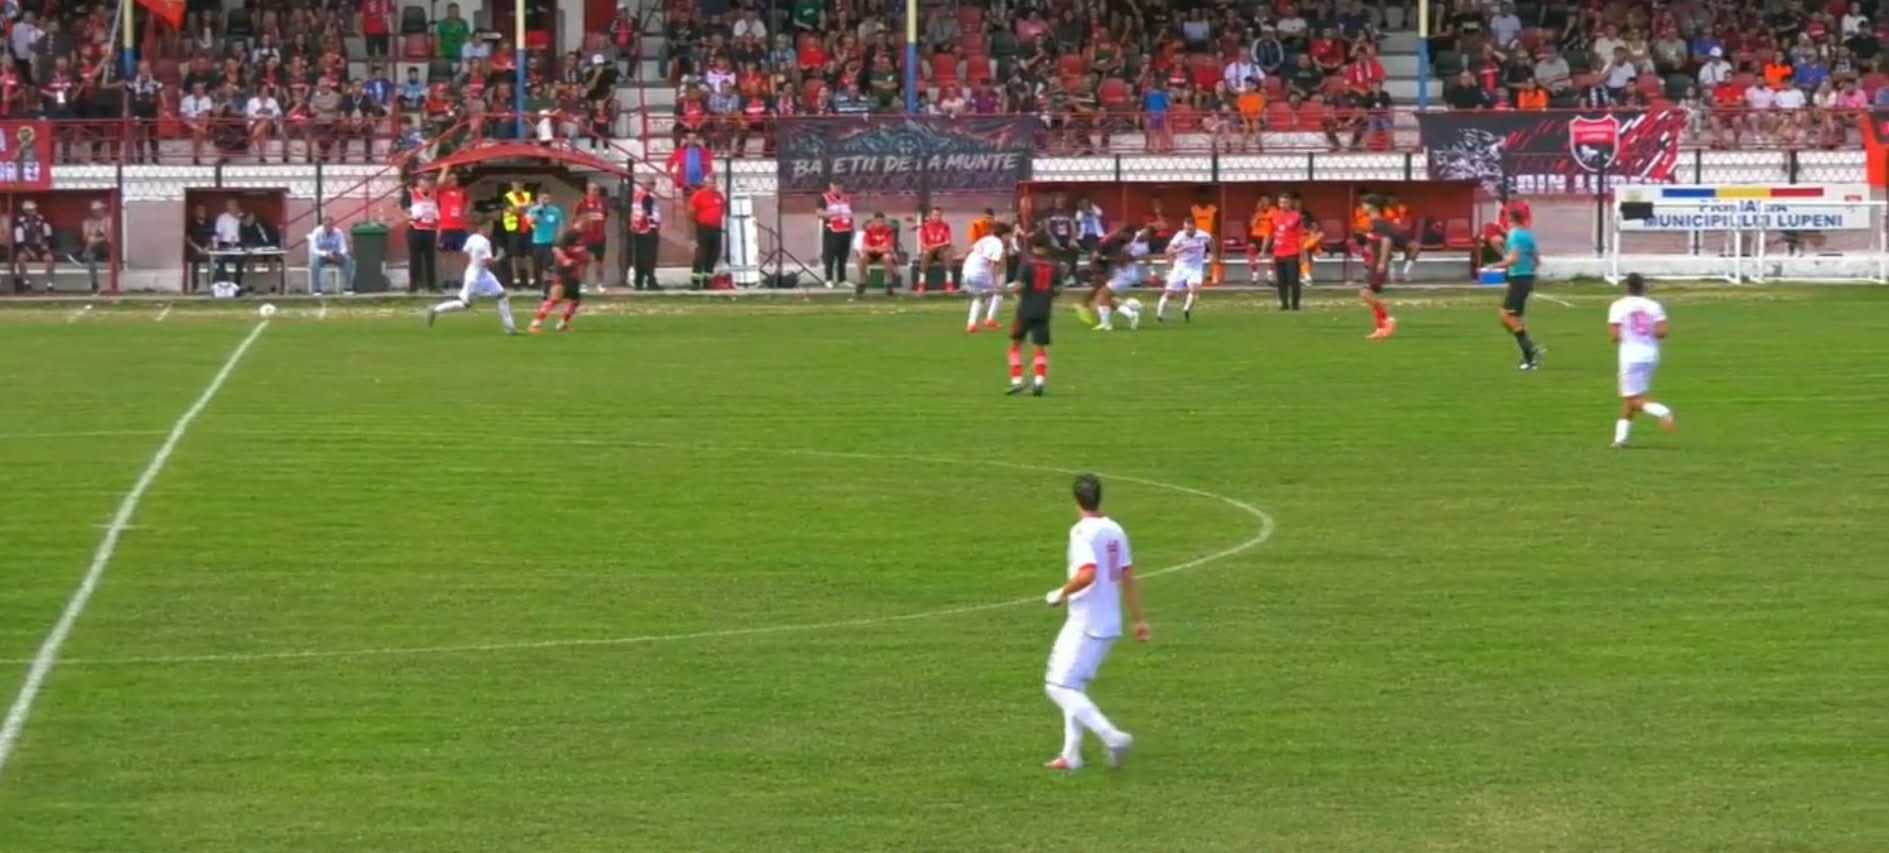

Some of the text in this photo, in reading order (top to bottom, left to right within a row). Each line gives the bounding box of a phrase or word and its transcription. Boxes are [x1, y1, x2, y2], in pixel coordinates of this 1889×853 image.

[793, 156, 878, 178] BAETII
[883, 154, 913, 173] DE
[944, 152, 1019, 173] MUNTE
[1778, 214, 1844, 228] LUPENI
